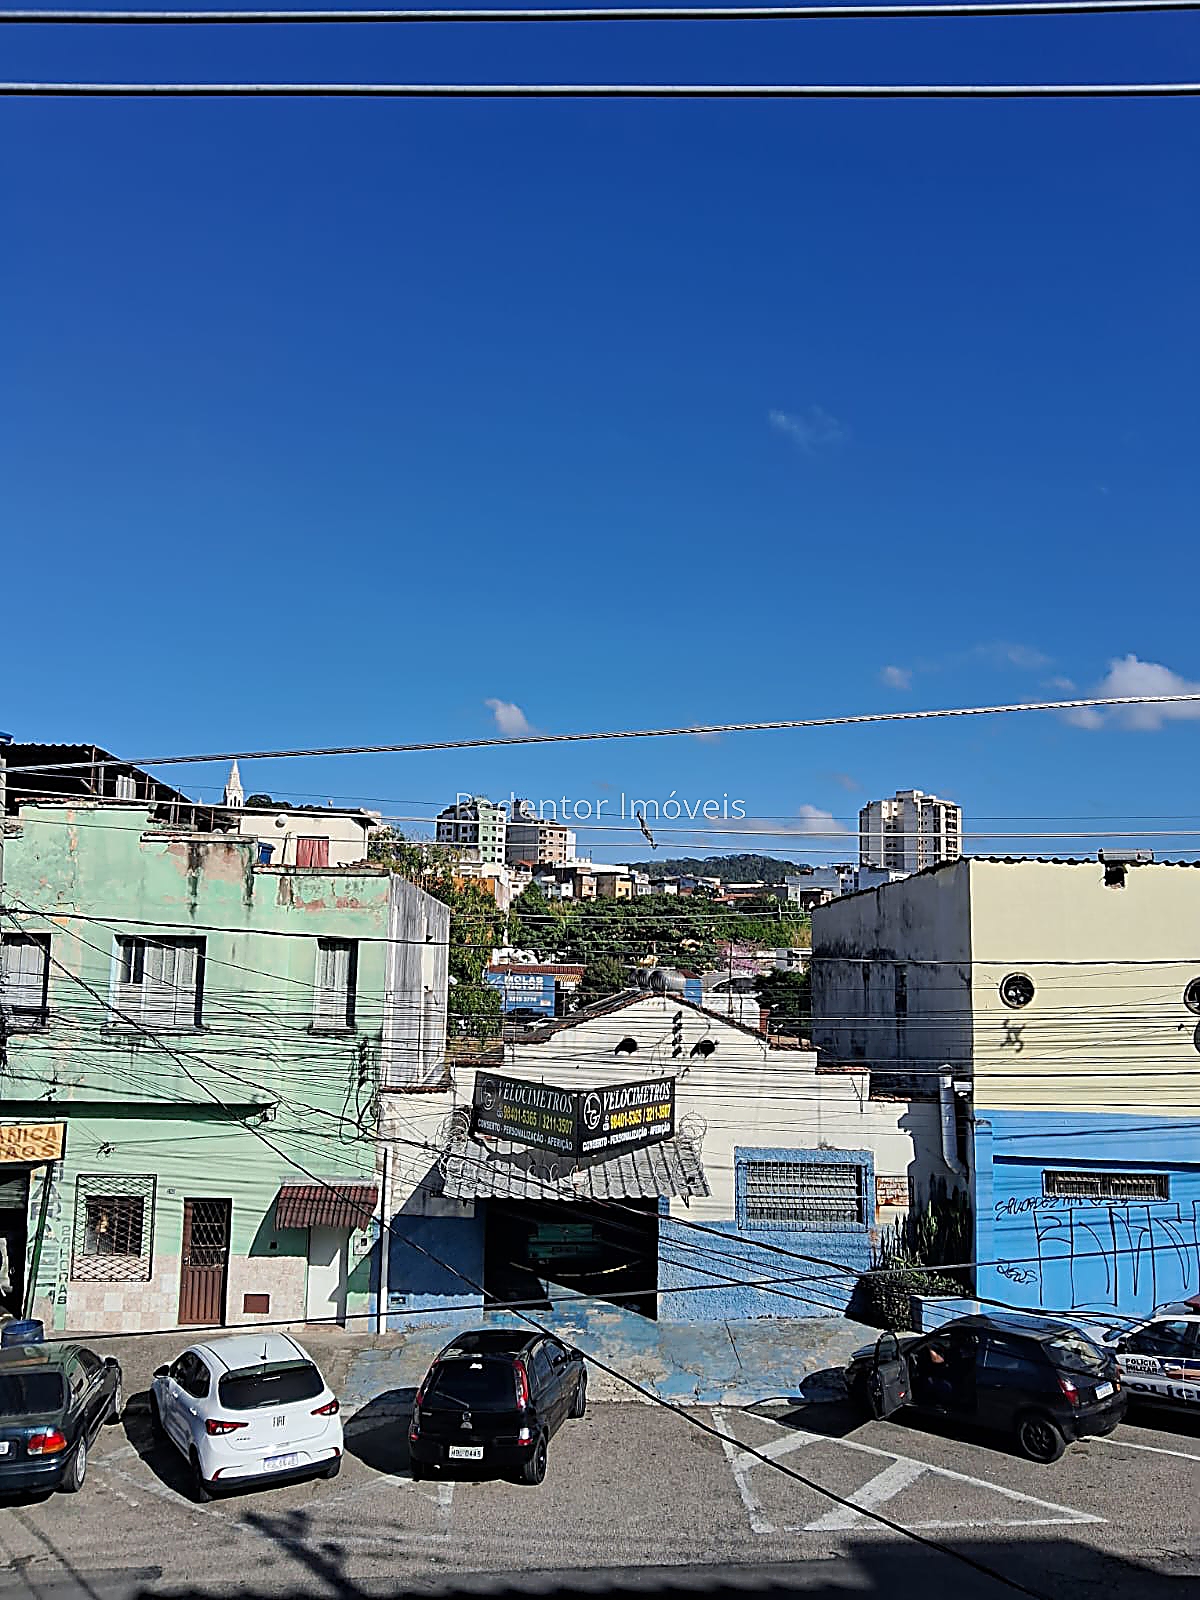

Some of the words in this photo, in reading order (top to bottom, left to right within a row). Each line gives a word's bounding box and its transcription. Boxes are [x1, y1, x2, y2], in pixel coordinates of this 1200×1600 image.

[505, 976, 543, 984] MOLAS
[477, 1119, 501, 1132] CONSERTO
[503, 1125, 544, 1144] PERSONALIZAÇÃO
[547, 1136, 573, 1151] AFERIÇÃO
